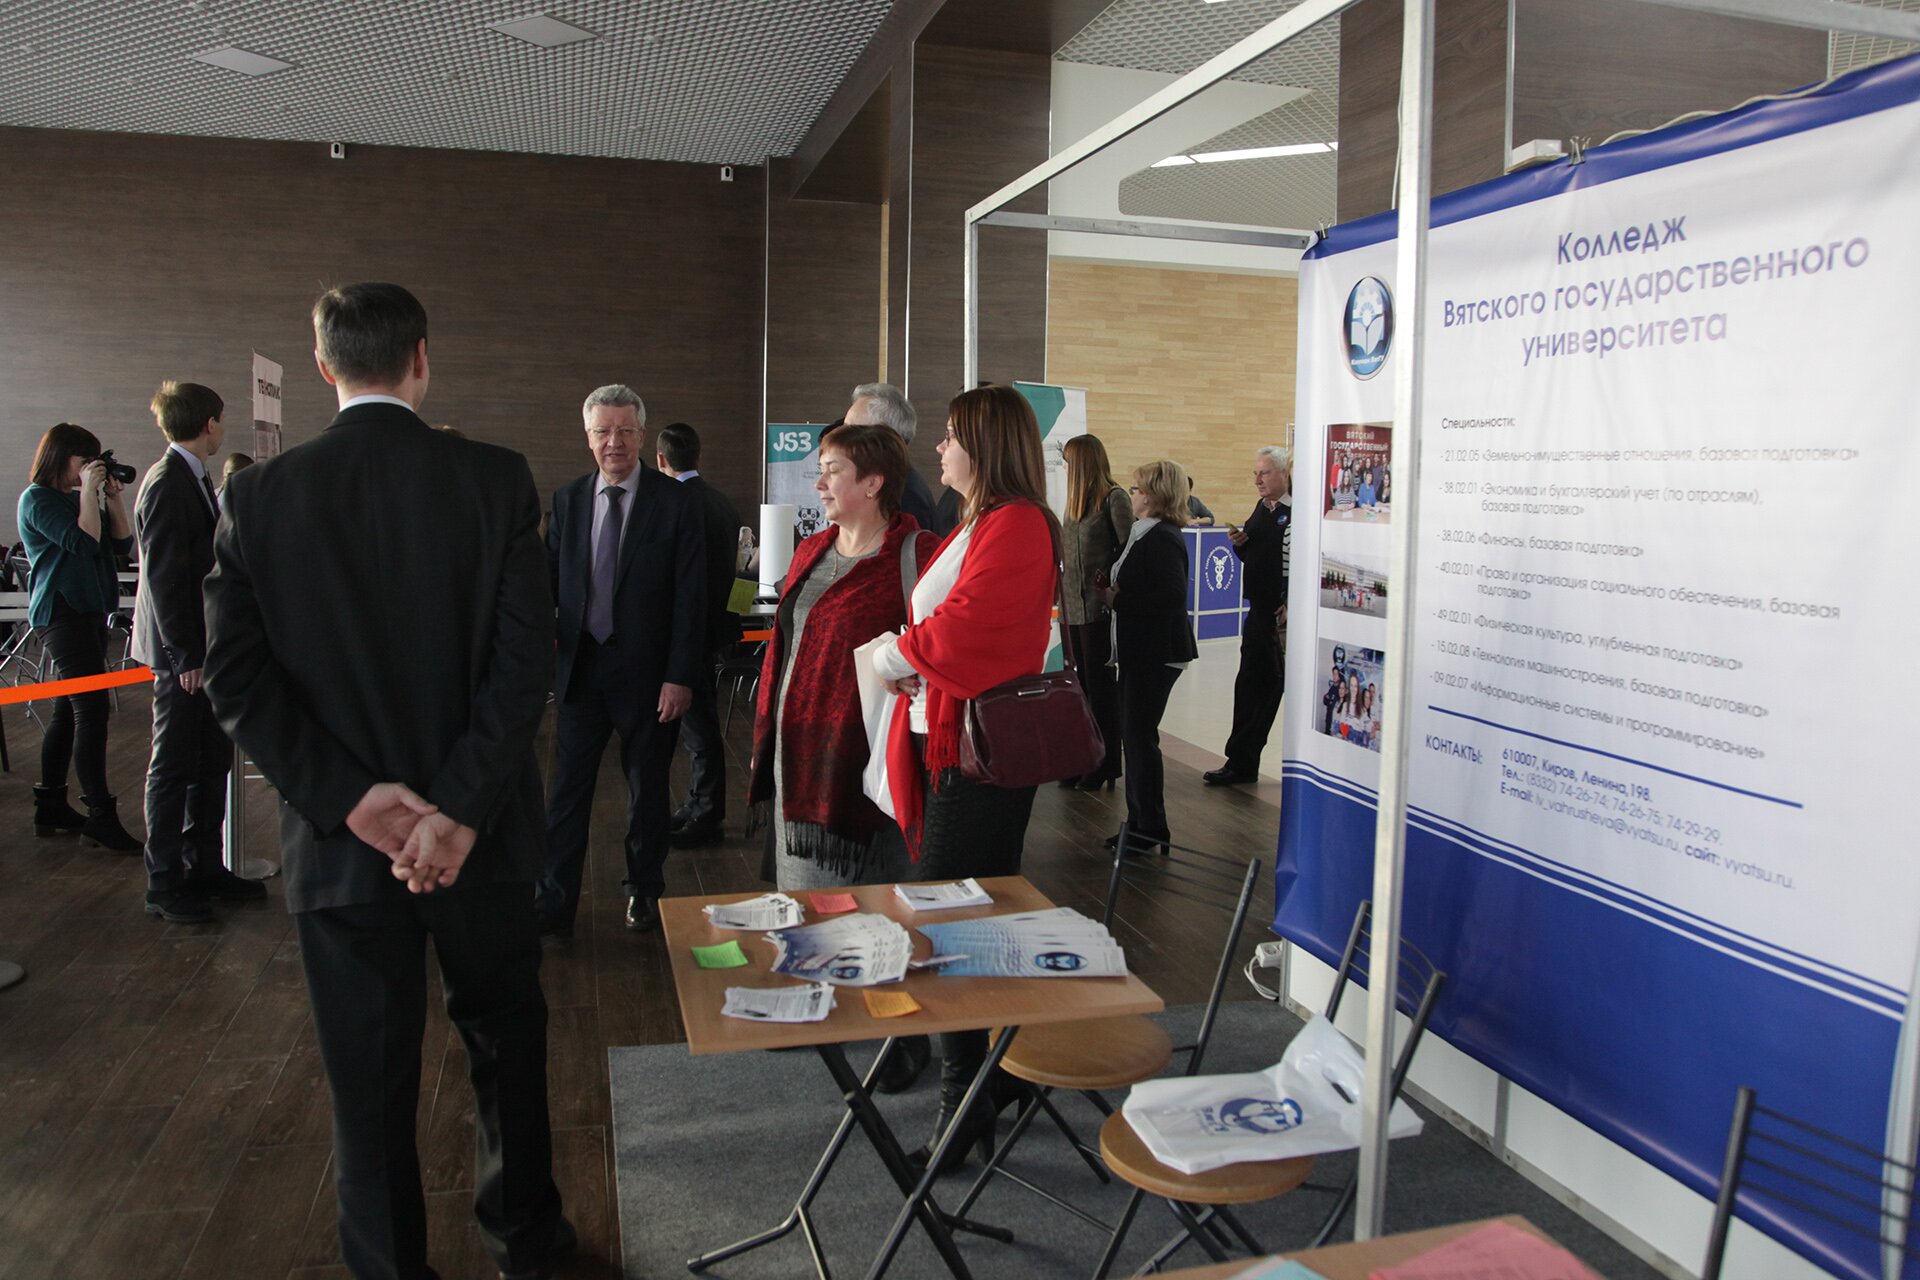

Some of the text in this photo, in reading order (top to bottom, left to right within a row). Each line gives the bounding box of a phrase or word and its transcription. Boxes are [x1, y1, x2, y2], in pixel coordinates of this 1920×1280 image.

[1557, 215, 1687, 265] Колледж
[1443, 236, 1870, 328] Вятского государственного
[1521, 312, 1728, 367] университета
[1441, 416, 1516, 430] Специальности:
[773, 431, 812, 452] JS3
[1699, 446, 1758, 461] базовая
[1762, 448, 1859, 463] подготовка»
[1481, 499, 1584, 516] базовая подготовка»
[1539, 487, 1546, 497] и
[1549, 483, 1631, 501] бухгалтерский
[1633, 487, 1659, 502] учет
[1663, 486, 1684, 502] (по
[1529, 535, 1573, 551] базовая
[1575, 541, 1644, 557] подготовка»
[1476, 564, 1511, 582] «Право
[1511, 571, 1518, 582] и
[1519, 571, 1588, 590] организация
[1590, 579, 1666, 600] социального
[1668, 587, 1766, 612] обеспечения,
[1769, 596, 1841, 620] базовая
[1477, 583, 1531, 600] подготовка»
[1588, 634, 1660, 657] углубленная
[1662, 646, 1743, 671] подготовка»
[1630, 677, 1683, 701] базовая
[1684, 691, 1769, 718] подготовка»
[1563, 702, 1613, 725] системы
[1615, 714, 1624, 727] и
[1625, 716, 1766, 760] программирование»
[1425, 733, 1483, 765] КОНТАКТЫ:
[1502, 747, 1539, 771] 610007,
[1541, 758, 1578, 783] Киров,
[1526, 770, 1558, 794] (8332)
[1500, 781, 1534, 804] E-mail:
[1684, 843, 1720, 866] сайт:
